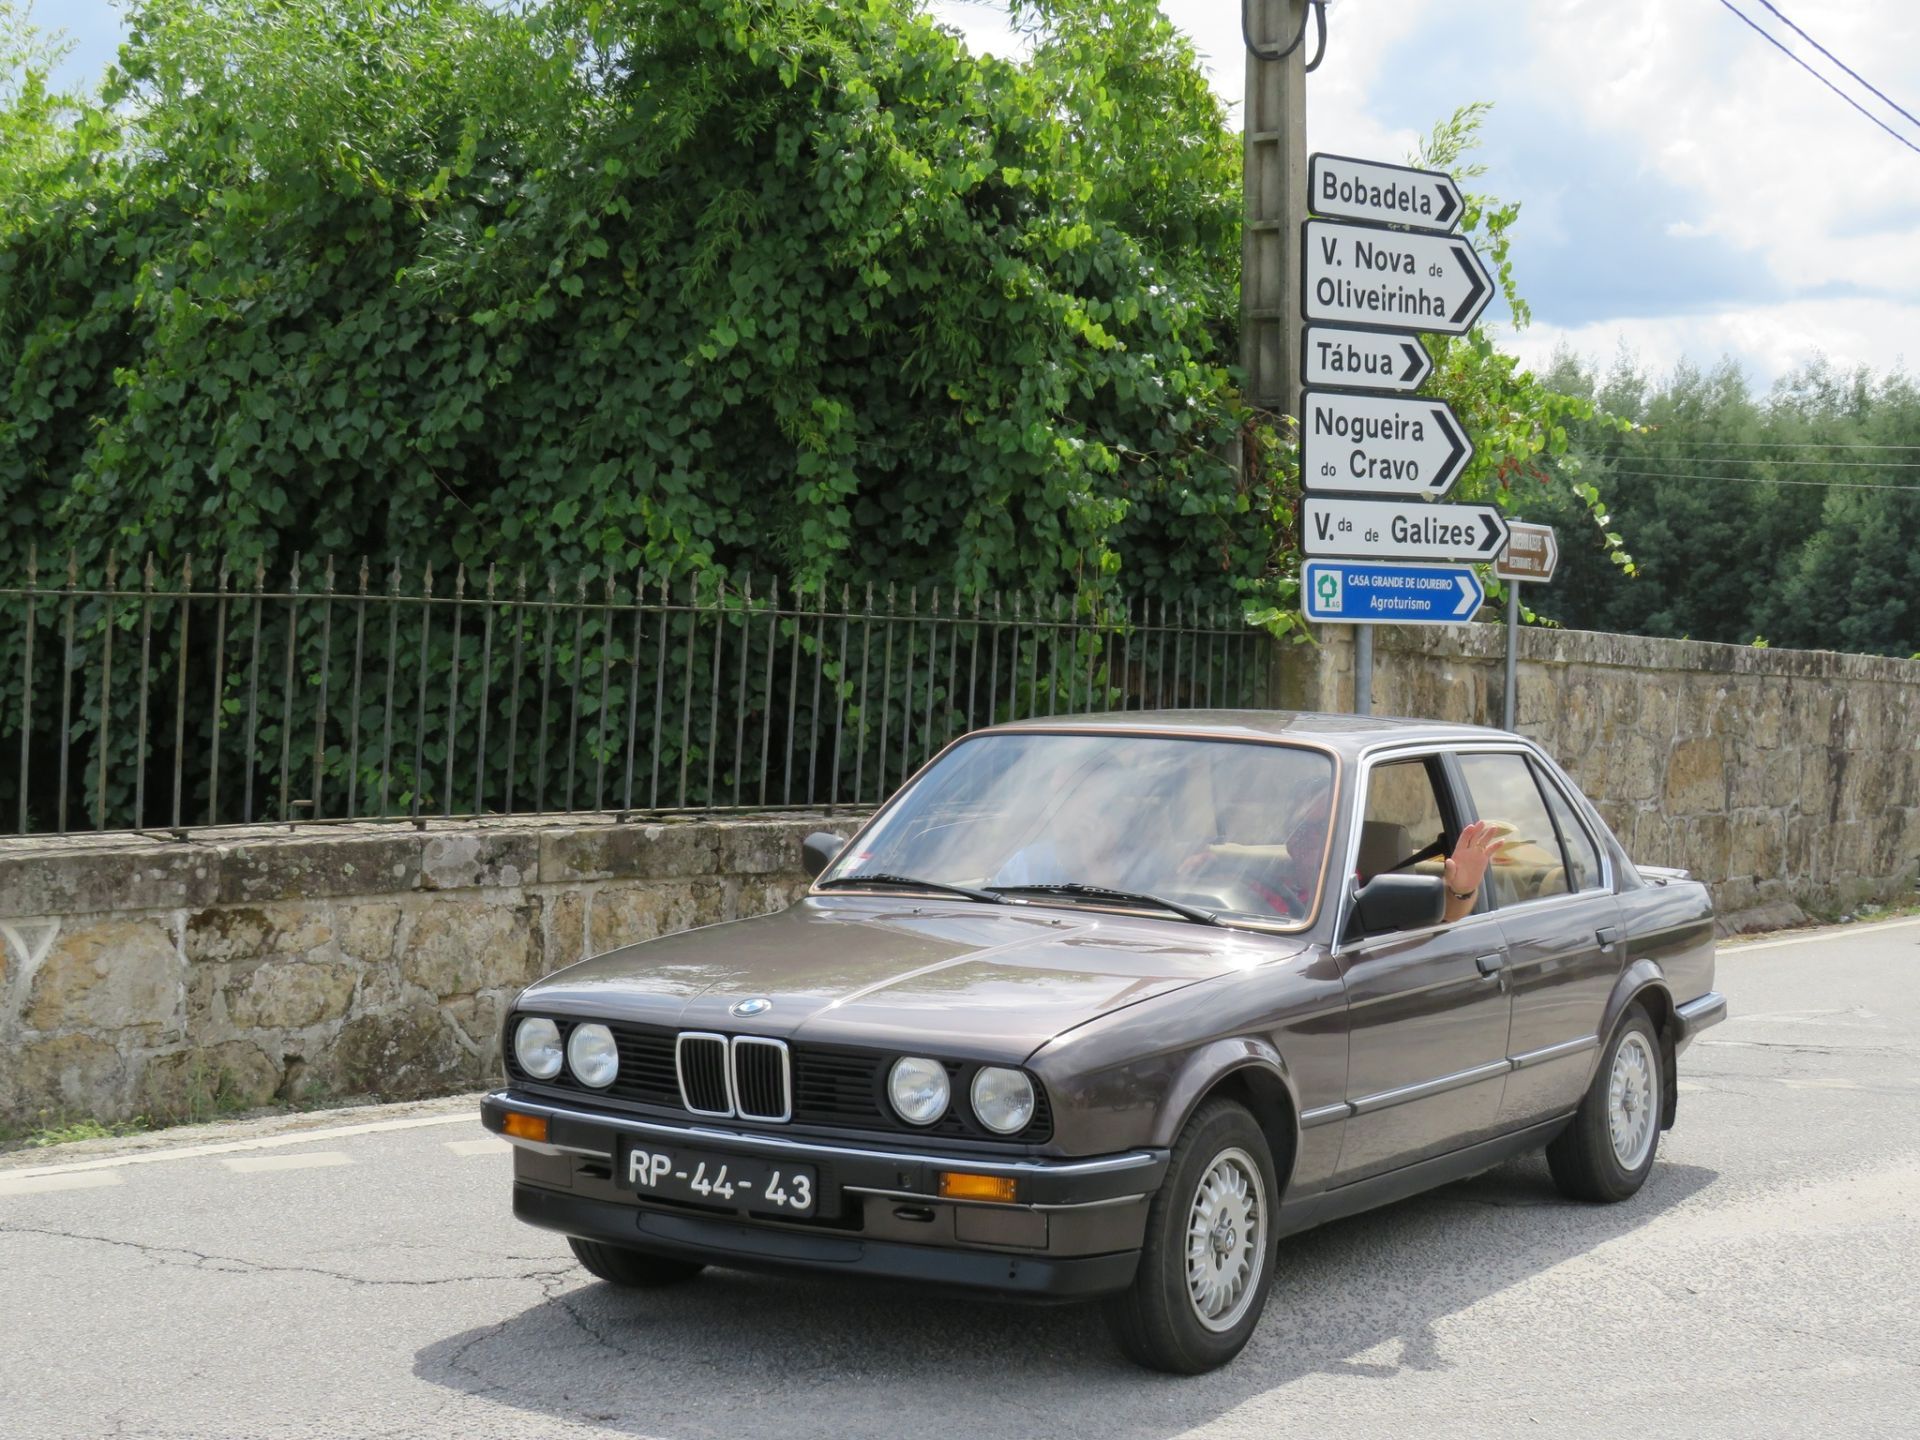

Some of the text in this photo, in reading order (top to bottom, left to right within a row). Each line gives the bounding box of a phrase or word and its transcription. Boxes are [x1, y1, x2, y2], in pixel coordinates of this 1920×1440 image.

[1323, 171, 1431, 215] Bobadela
[1321, 236, 1443, 278] V. Nova de
[1316, 277, 1445, 317] Oliveirinha
[1317, 341, 1393, 375] Tábua
[1315, 406, 1424, 443] Nogueira
[1321, 449, 1419, 480] do Cravo
[1364, 528, 1379, 542] de
[1391, 515, 1475, 545] Galizes
[1348, 575, 1453, 590] CASA GRANDE DE LOUREIRO
[1370, 595, 1431, 610] Agroturismo
